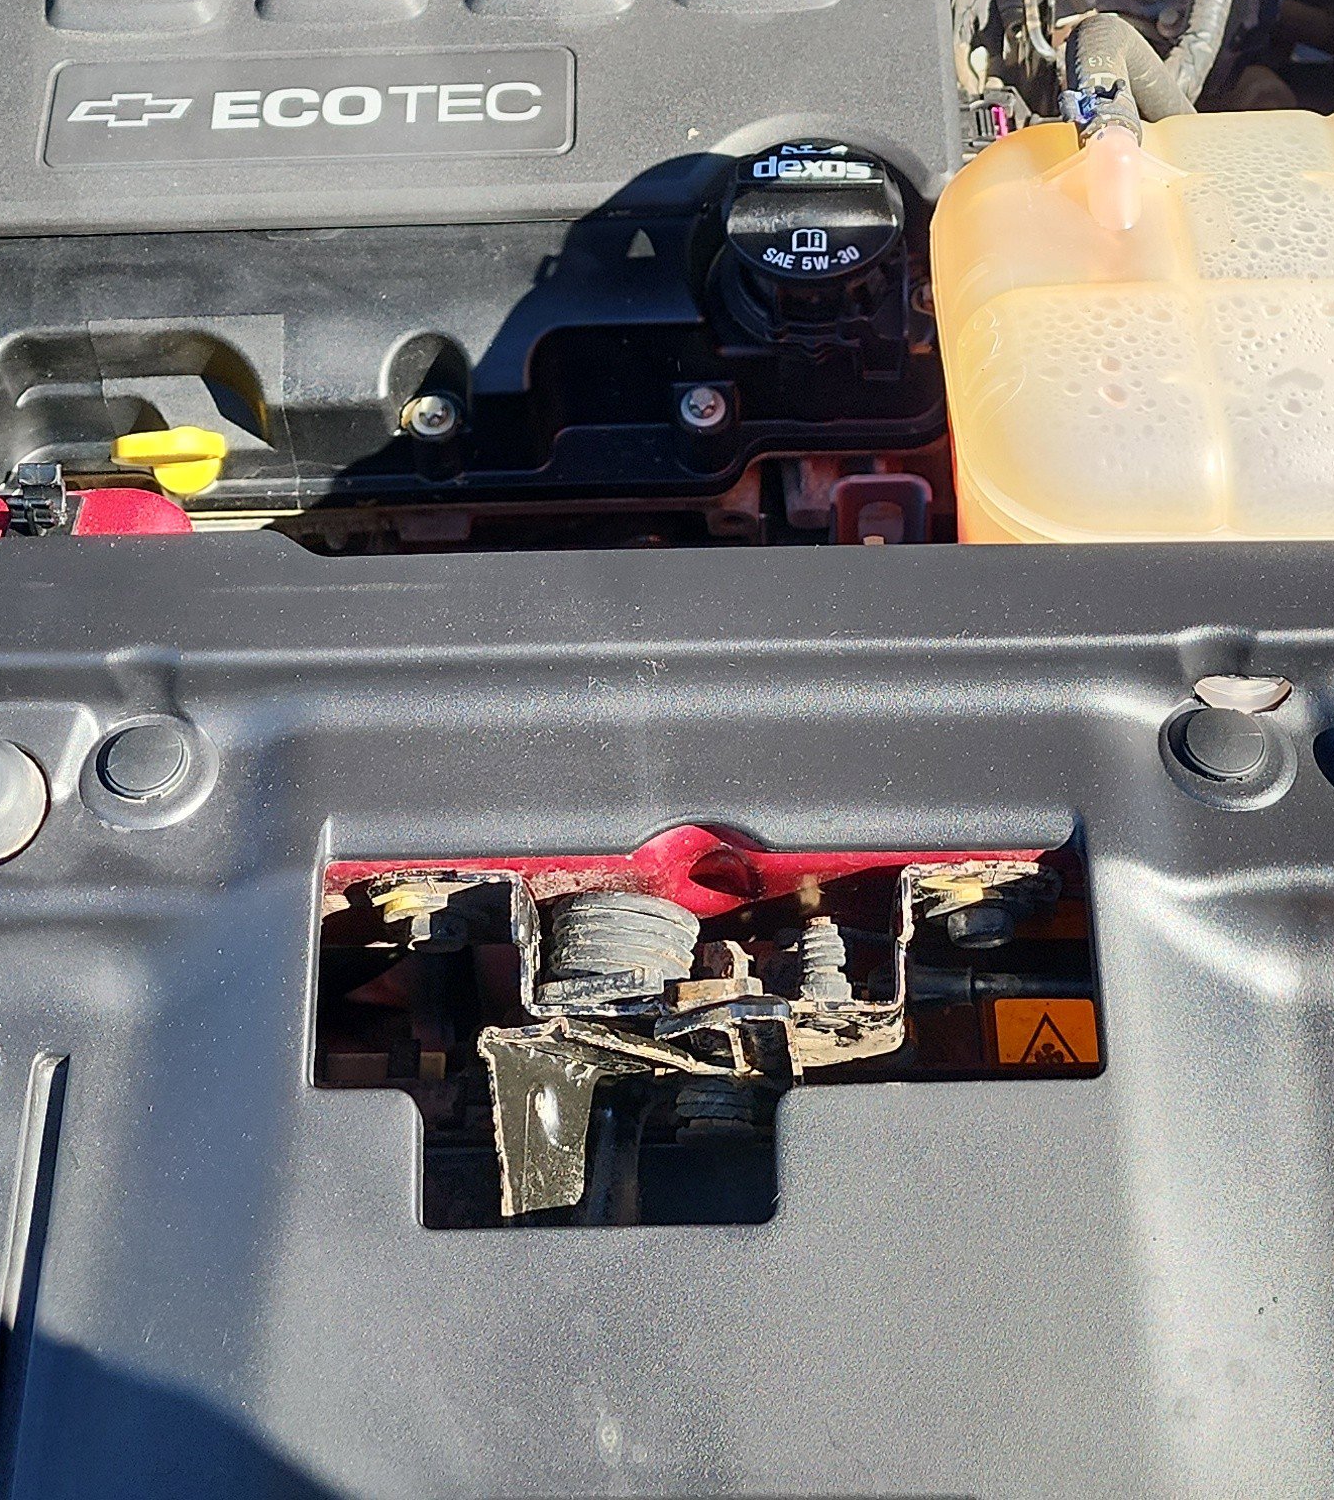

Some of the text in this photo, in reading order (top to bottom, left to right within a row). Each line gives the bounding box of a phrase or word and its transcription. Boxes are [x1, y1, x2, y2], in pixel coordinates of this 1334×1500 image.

[211, 82, 542, 130] ECOTEC
[753, 156, 871, 178] dexos
[763, 245, 860, 270] SAE 5W-30
